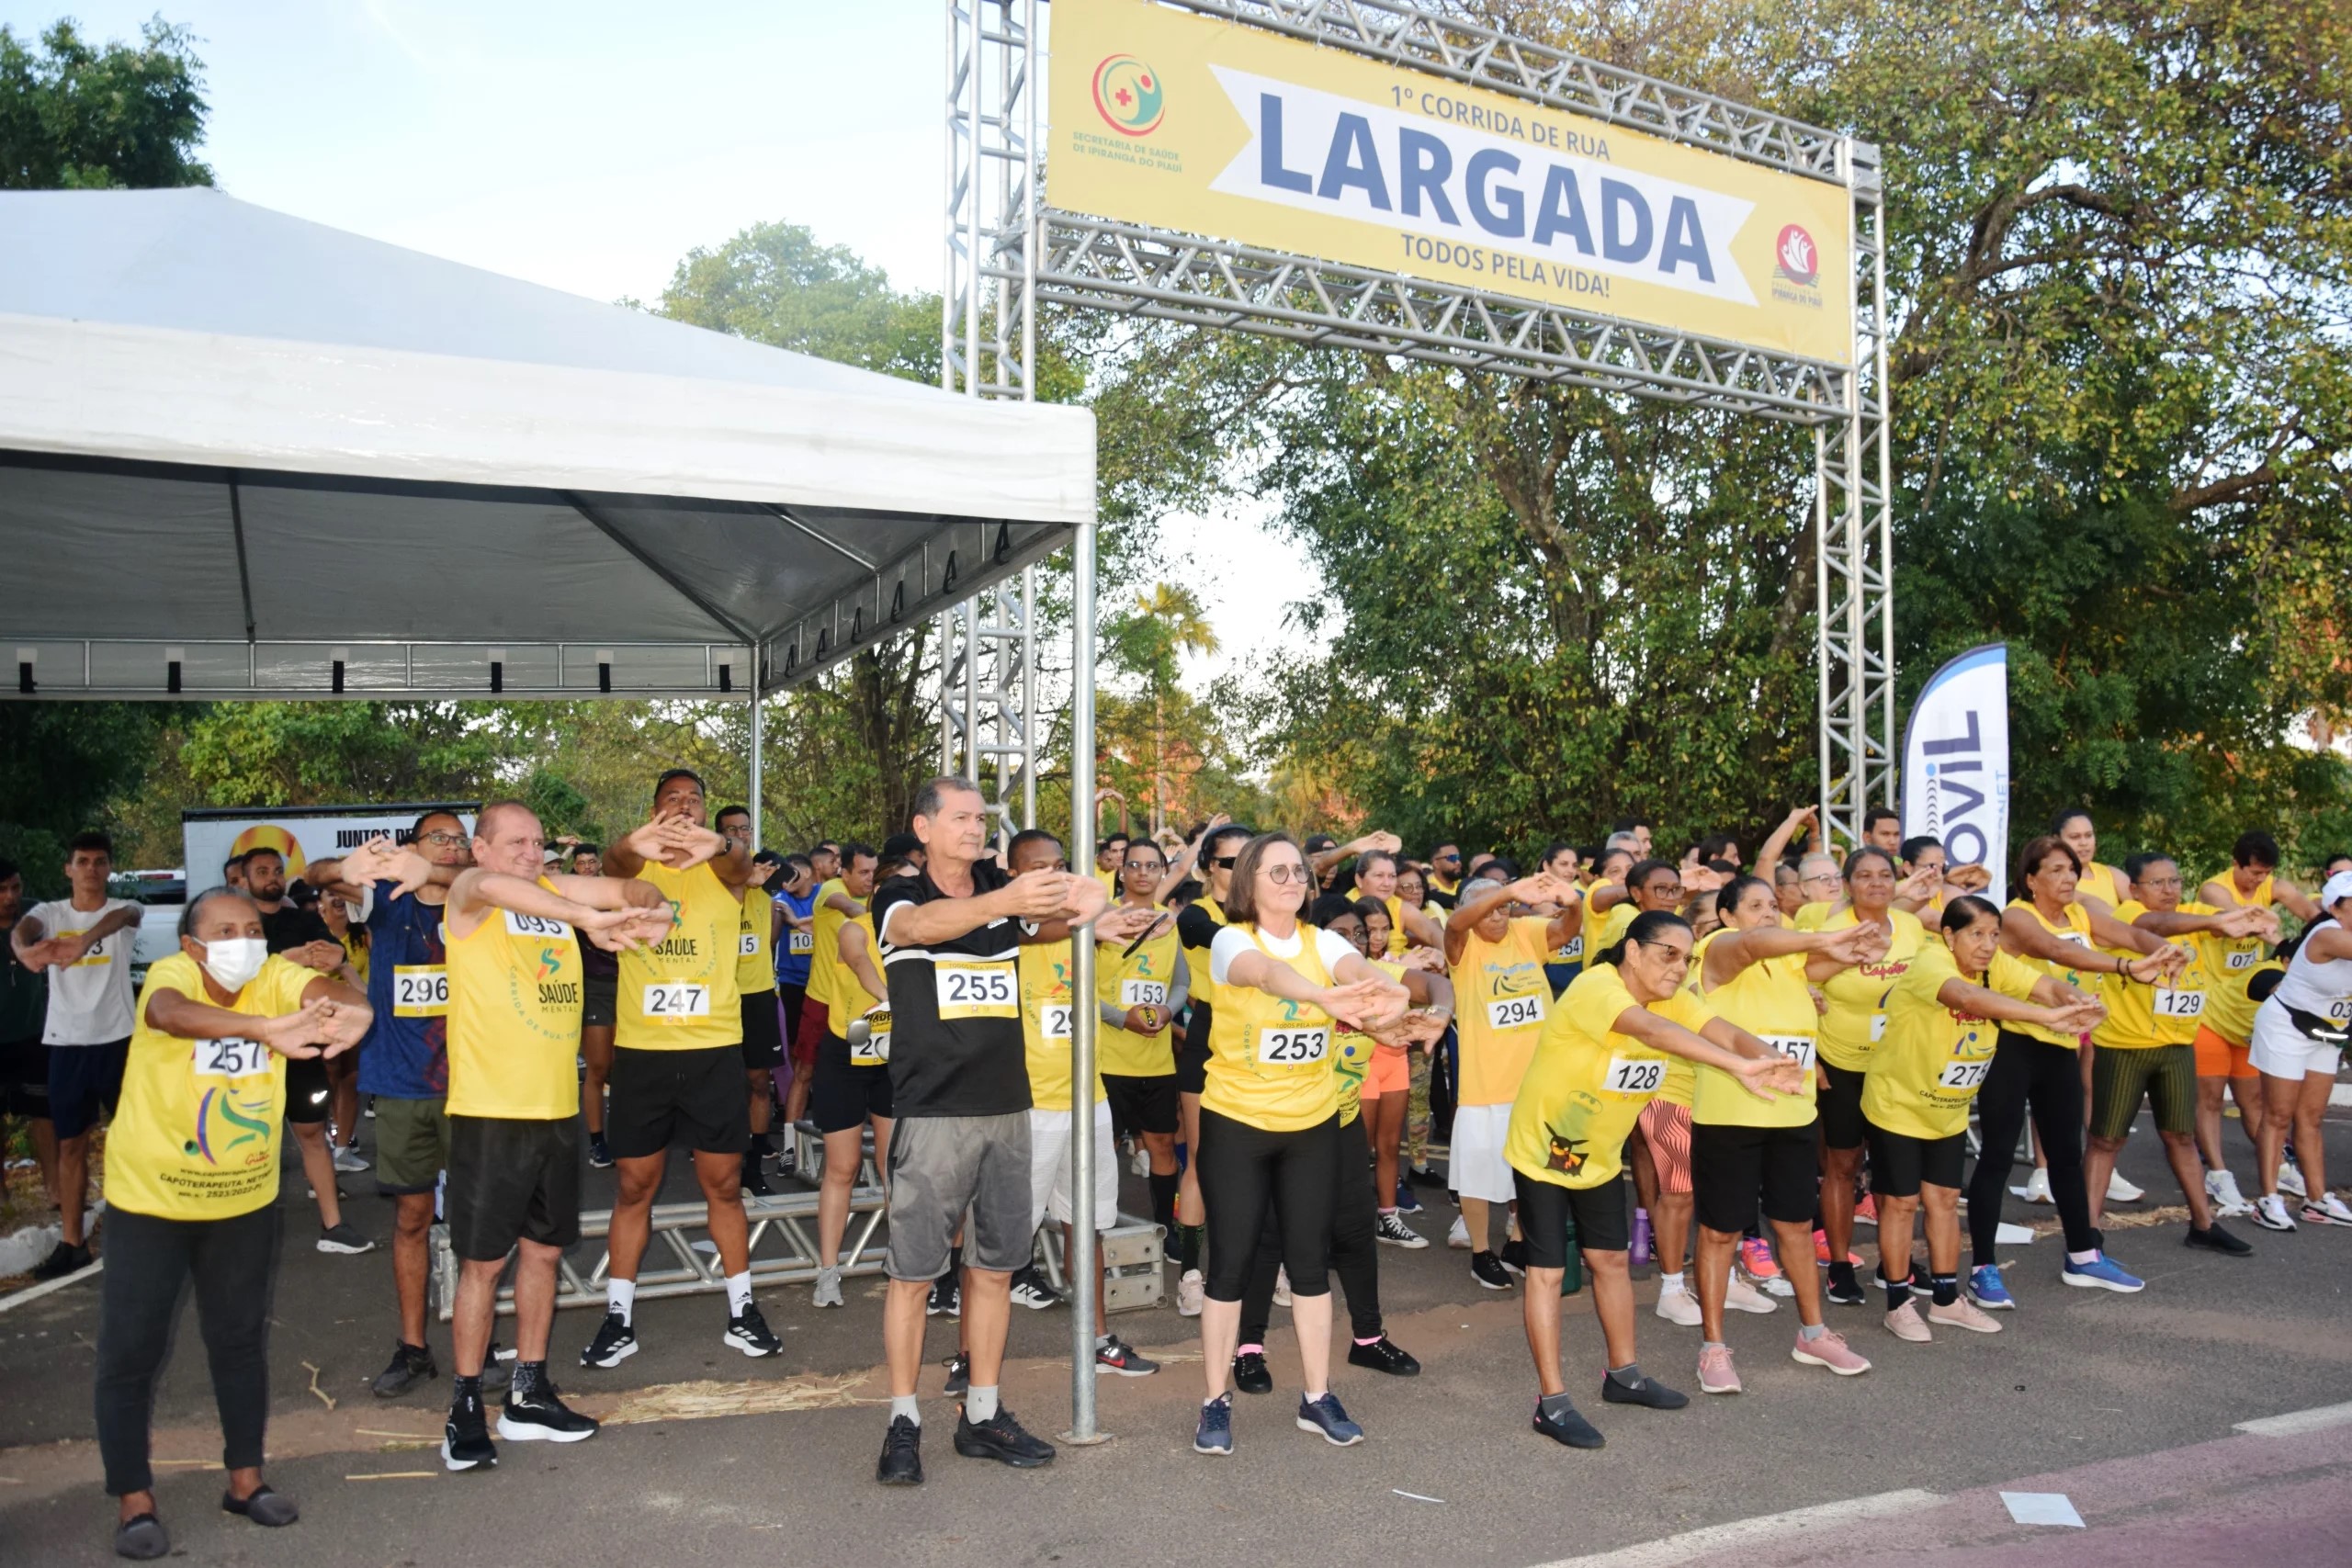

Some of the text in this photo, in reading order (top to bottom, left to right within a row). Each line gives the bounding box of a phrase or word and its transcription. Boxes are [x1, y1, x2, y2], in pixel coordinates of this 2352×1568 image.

[1391, 85, 1610, 161] 1º CORRIDA DE RUA
[1073, 131, 1180, 161] SECRETARIA DE SAÚDE
[1073, 143, 1085, 153] DE
[1089, 146, 1136, 164] IPIRANGA
[1139, 157, 1154, 167] DO
[1261, 92, 1716, 284] LARGADA
[1401, 233, 1610, 299] TODOS PELA VIDA!
[656, 934, 698, 955] SAÚDE
[1559, 938, 1580, 956] 54
[401, 977, 448, 1002] 296
[538, 979, 579, 1003] SAÚDE
[651, 988, 701, 1012] 247
[948, 974, 1009, 1001] 255
[1130, 983, 1163, 1004] 153
[1497, 999, 1537, 1025] 294
[2165, 993, 2200, 1013] 129
[209, 1039, 260, 1073] 257
[1269, 1032, 1324, 1060] 253
[1618, 1066, 1659, 1089] 128
